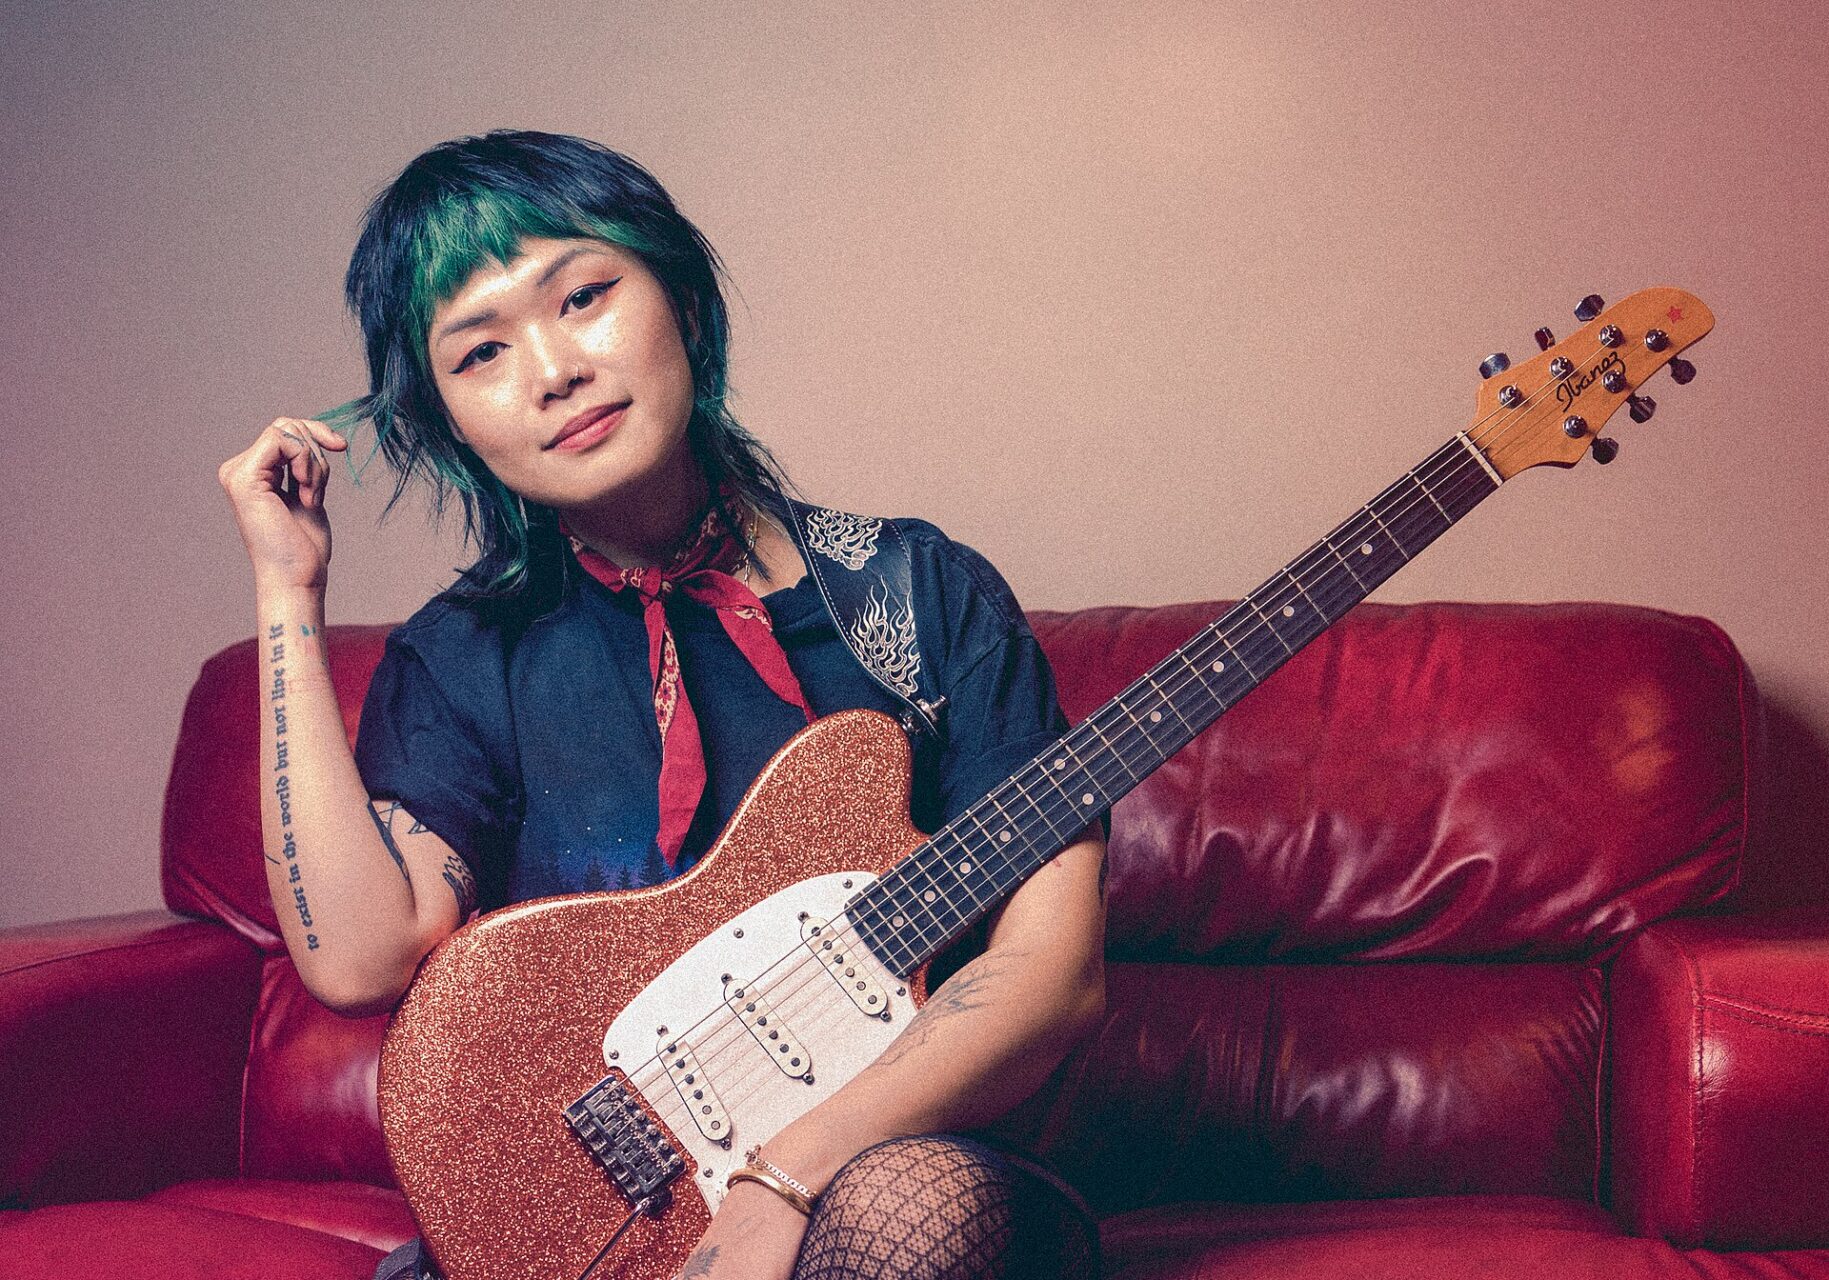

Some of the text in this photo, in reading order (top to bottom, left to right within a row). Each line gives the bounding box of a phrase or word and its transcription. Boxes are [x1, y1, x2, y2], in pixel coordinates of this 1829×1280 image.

[1556, 351, 1626, 413] Ibanez
[269, 623, 320, 951] to exist in the world but not live in it
